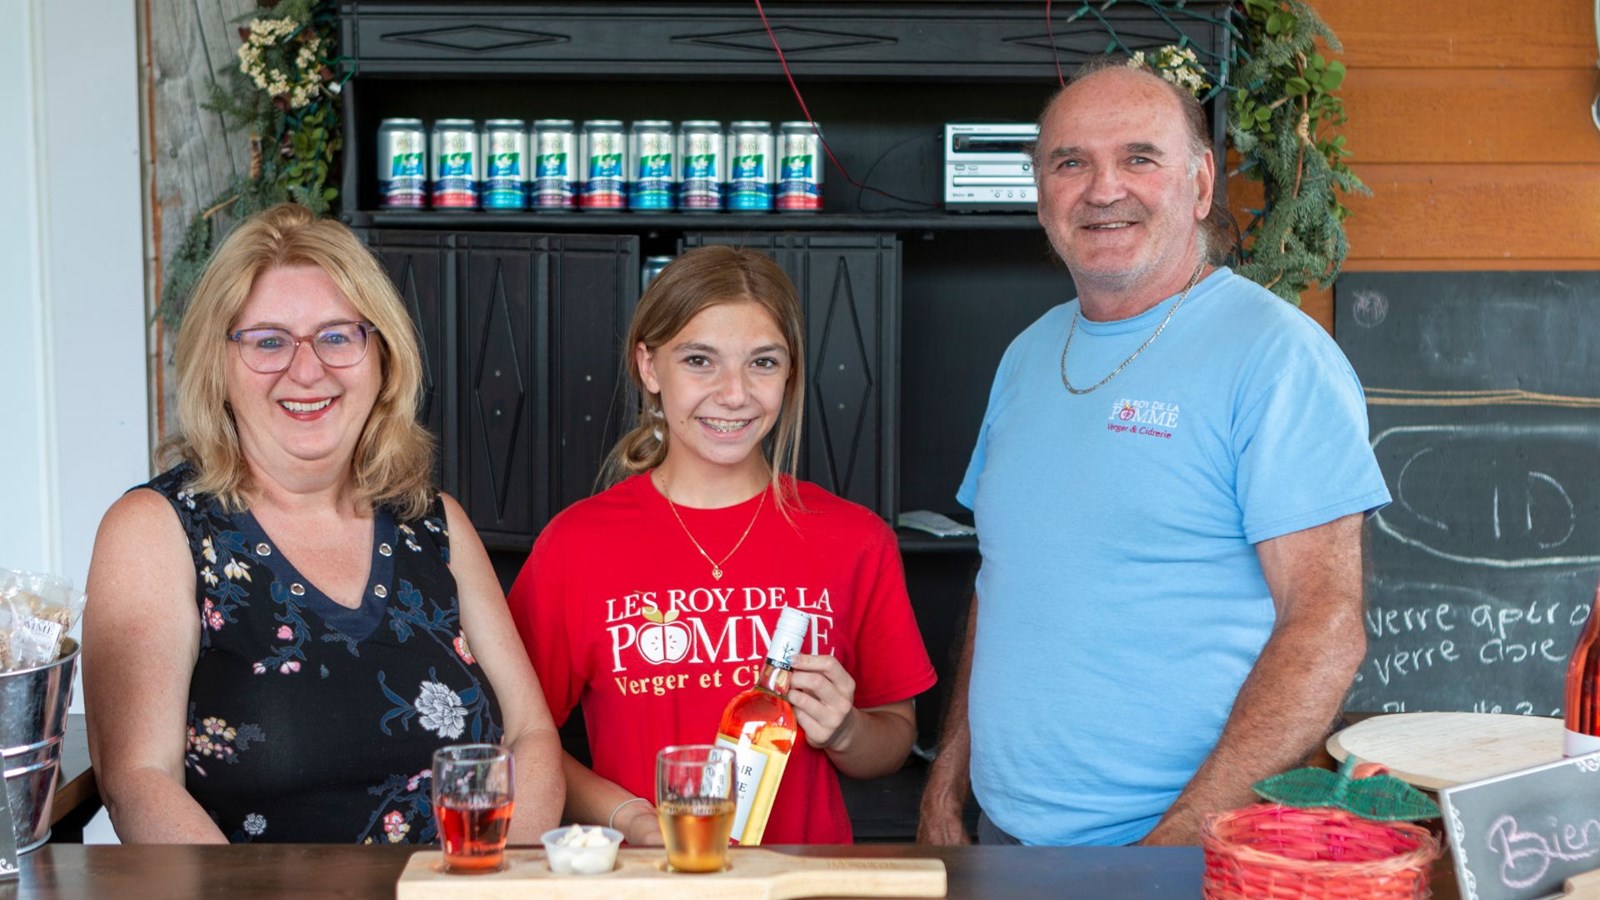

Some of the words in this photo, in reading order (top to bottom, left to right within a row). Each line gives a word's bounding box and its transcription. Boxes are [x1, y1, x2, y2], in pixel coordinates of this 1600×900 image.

[1108, 404, 1180, 428] POMME
[1133, 399, 1149, 409] ROY
[1151, 401, 1165, 410] DE
[1165, 402, 1180, 413] LA
[1107, 422, 1129, 433] Verger
[1129, 424, 1138, 433] &
[1138, 426, 1172, 440] Cidrerie
[605, 591, 659, 623] LES
[667, 587, 735, 613] ROY
[742, 586, 789, 612] DE
[795, 586, 834, 614] LA
[614, 673, 690, 697] Verger
[699, 669, 723, 689] et
